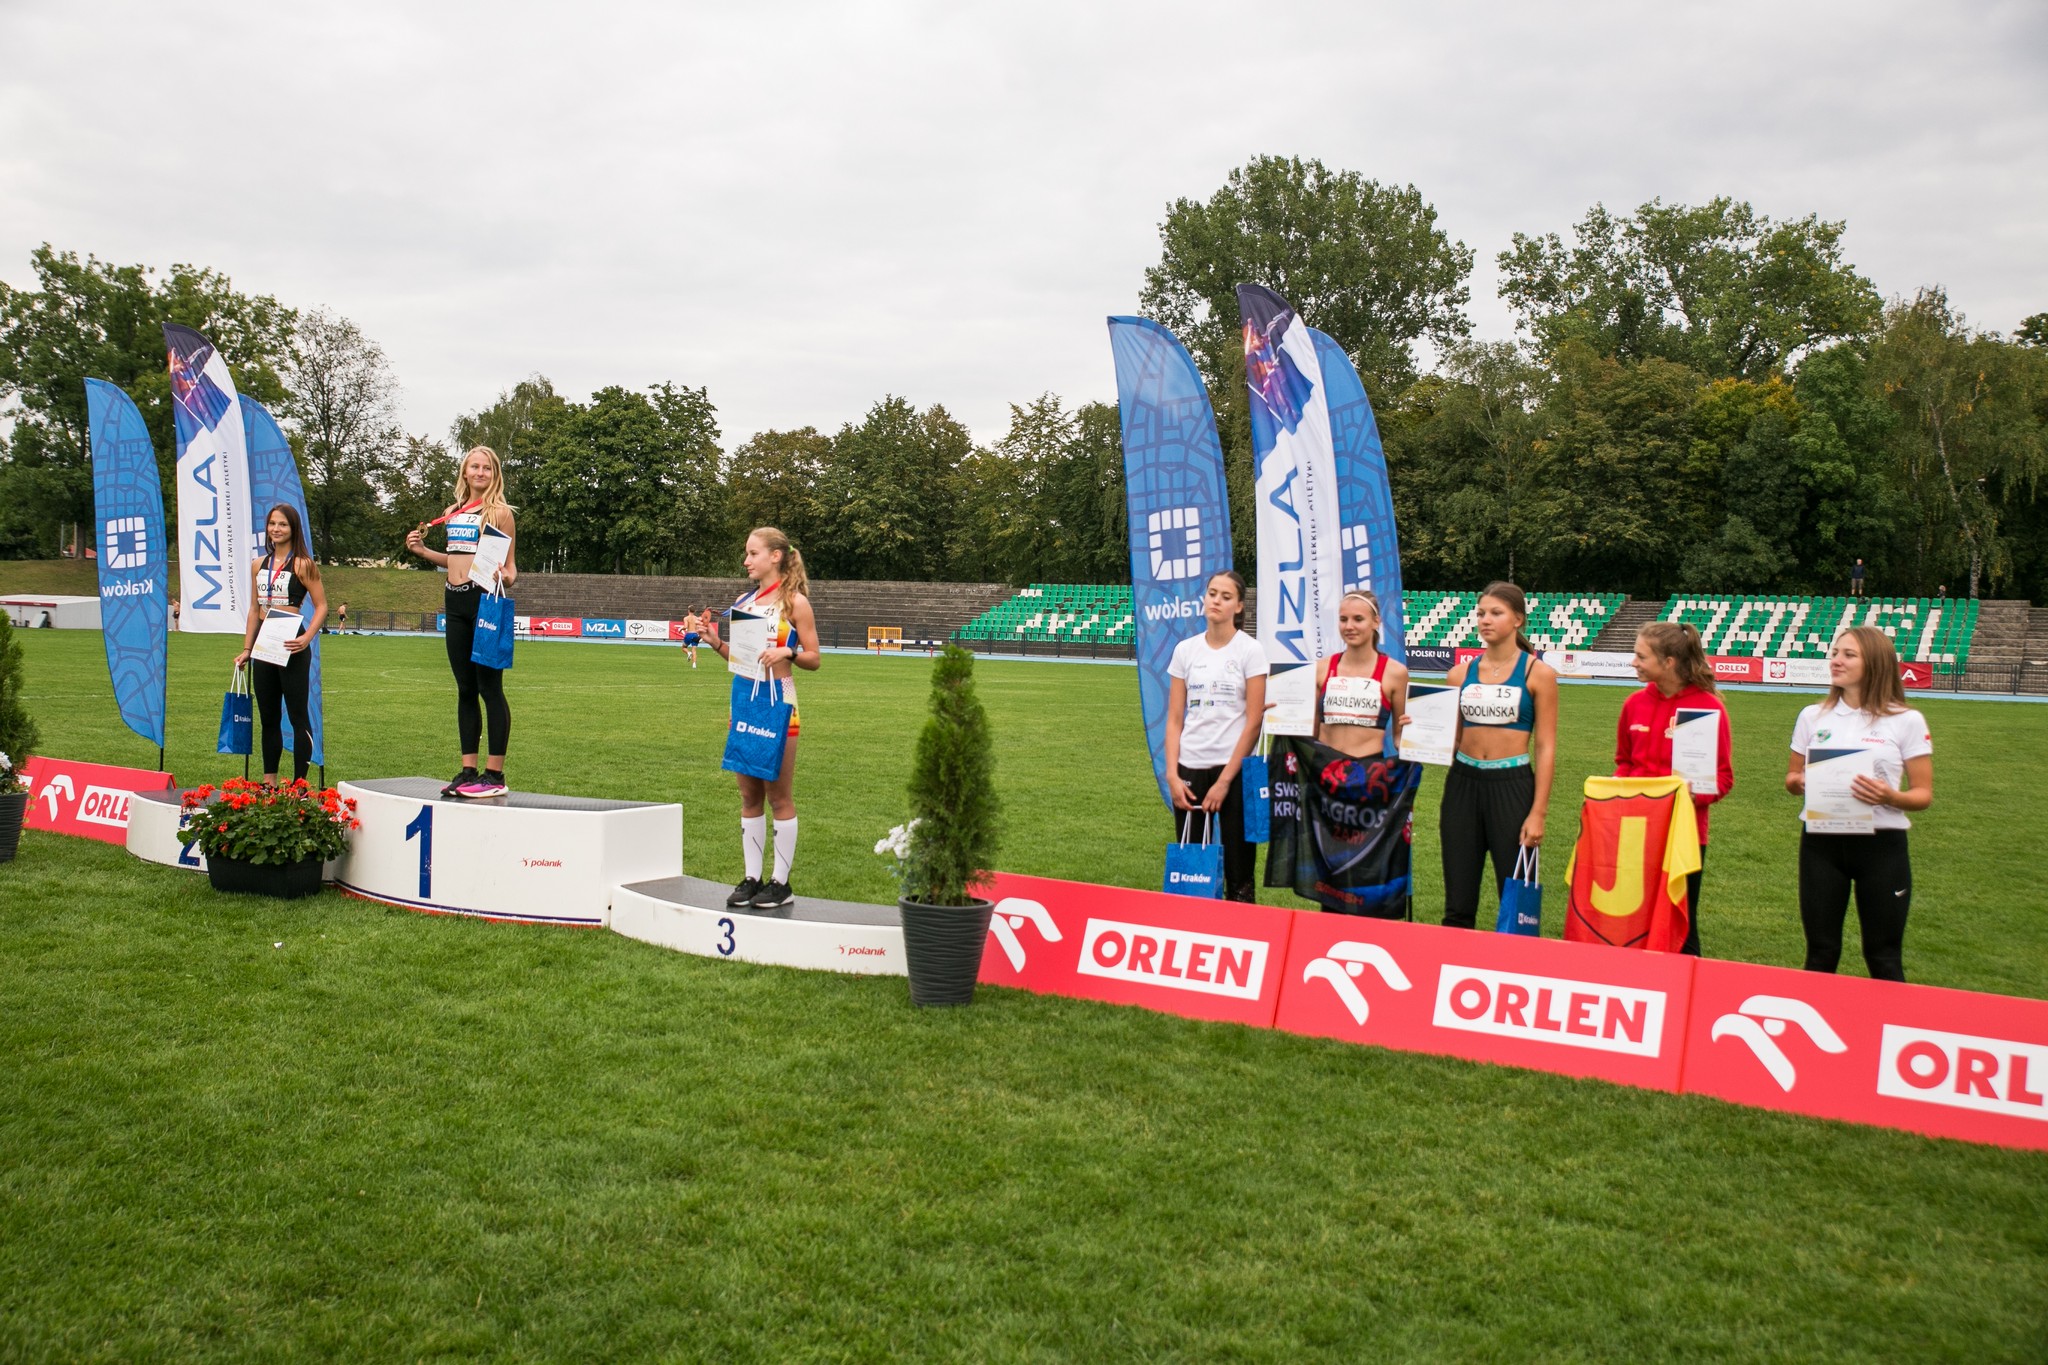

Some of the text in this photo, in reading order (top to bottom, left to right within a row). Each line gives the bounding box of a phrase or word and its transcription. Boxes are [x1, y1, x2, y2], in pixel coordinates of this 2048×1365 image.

[192, 453, 222, 610] MZLA
[1312, 568, 1320, 619] ZWIĄZEK
[764, 608, 775, 616] 41
[586, 623, 621, 632] MZLA
[1411, 650, 1436, 658] POLSKI
[1718, 664, 1747, 672] ORLEN
[1364, 681, 1371, 690] 7
[1496, 688, 1511, 698] 15
[1326, 696, 1377, 709] WASILEWSKA
[748, 725, 776, 738] Kraków
[1321, 797, 1388, 828] AGROS
[405, 804, 433, 898] 1
[531, 858, 562, 867] polanik
[1589, 816, 1647, 917] J
[1181, 873, 1211, 883] Kraków
[716, 917, 736, 956] 3
[848, 945, 886, 956] polanik
[1092, 929, 1253, 988] ORLEN
[1449, 977, 1648, 1044] ORLEN
[1896, 1040, 2044, 1107] ORL
